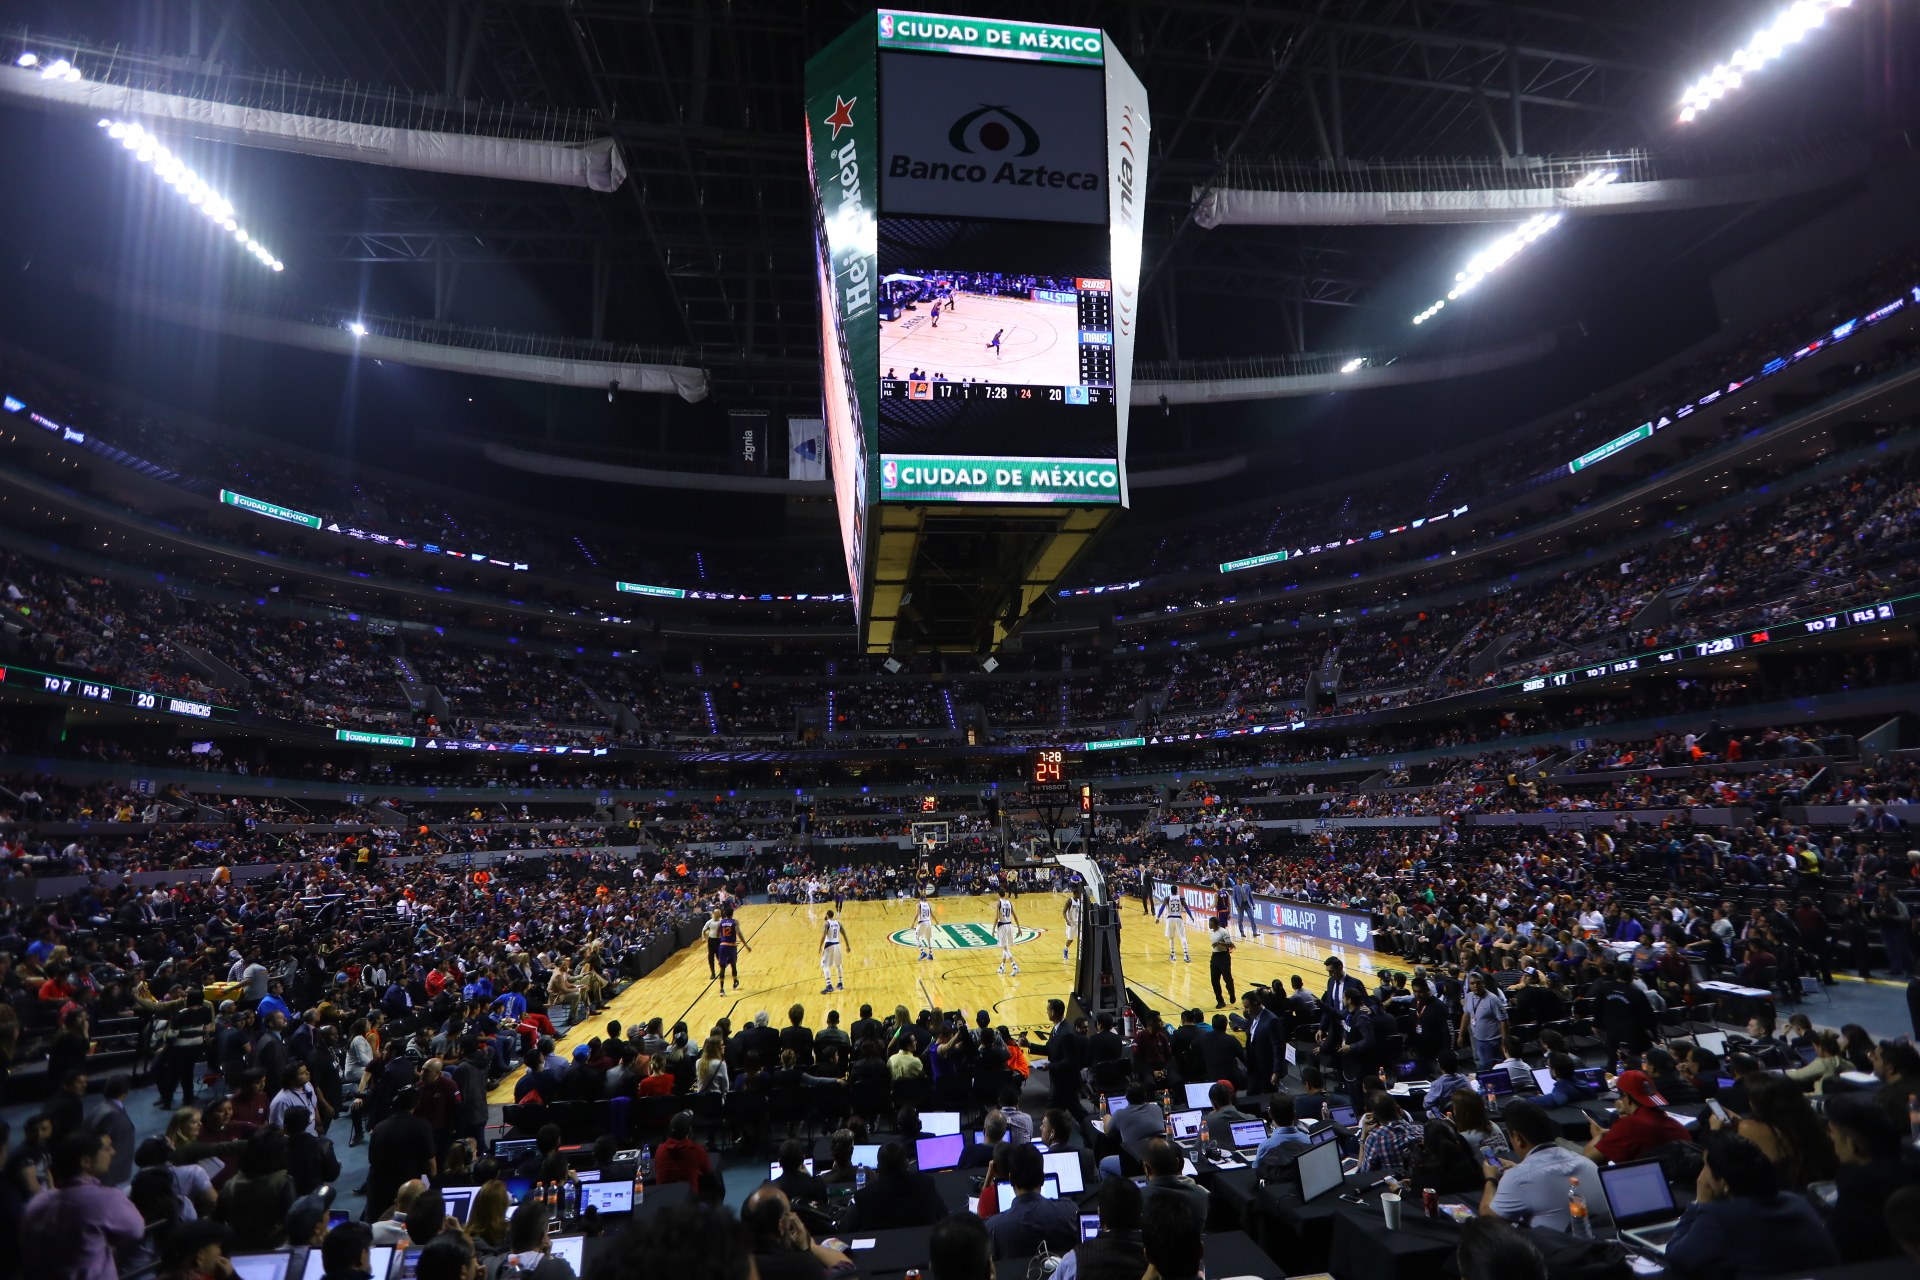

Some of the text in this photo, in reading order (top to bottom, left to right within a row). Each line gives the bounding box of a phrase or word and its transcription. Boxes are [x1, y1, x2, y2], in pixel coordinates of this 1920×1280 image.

[897, 21, 1101, 52] CIUDAD DE MÉXICO
[889, 155, 1099, 191] Banco Azteca
[838, 139, 871, 315] Heiken
[1081, 280, 1106, 289] SUNS
[940, 386, 1062, 400] 17 1 7:28 24 20
[743, 430, 756, 462] zignia
[901, 465, 1117, 488] CIUDAD DE MÉXICO
[239, 498, 309, 522] CIUDAD DE MÉXICO
[1804, 606, 1891, 632] TO 7 FLS 2
[1697, 632, 1769, 656] 7:28 24
[1658, 653, 1674, 662] 1st
[1586, 660, 1637, 678] TO 7 FLS 2
[44, 677, 110, 699] TO 7 FLS 2
[1522, 674, 1567, 692] SUNS 17
[137, 694, 212, 717] 20 MAVERICKS
[350, 734, 371, 742] CIUDAD
[1040, 751, 1062, 762] 7:28
[1037, 764, 1059, 781] 24
[1170, 904, 1179, 913] 23
[1183, 889, 1204, 909] VOTA
[1281, 907, 1299, 927] NBA
[1299, 911, 1316, 931] APP
[722, 927, 731, 937] 12
[833, 929, 837, 939] 8
